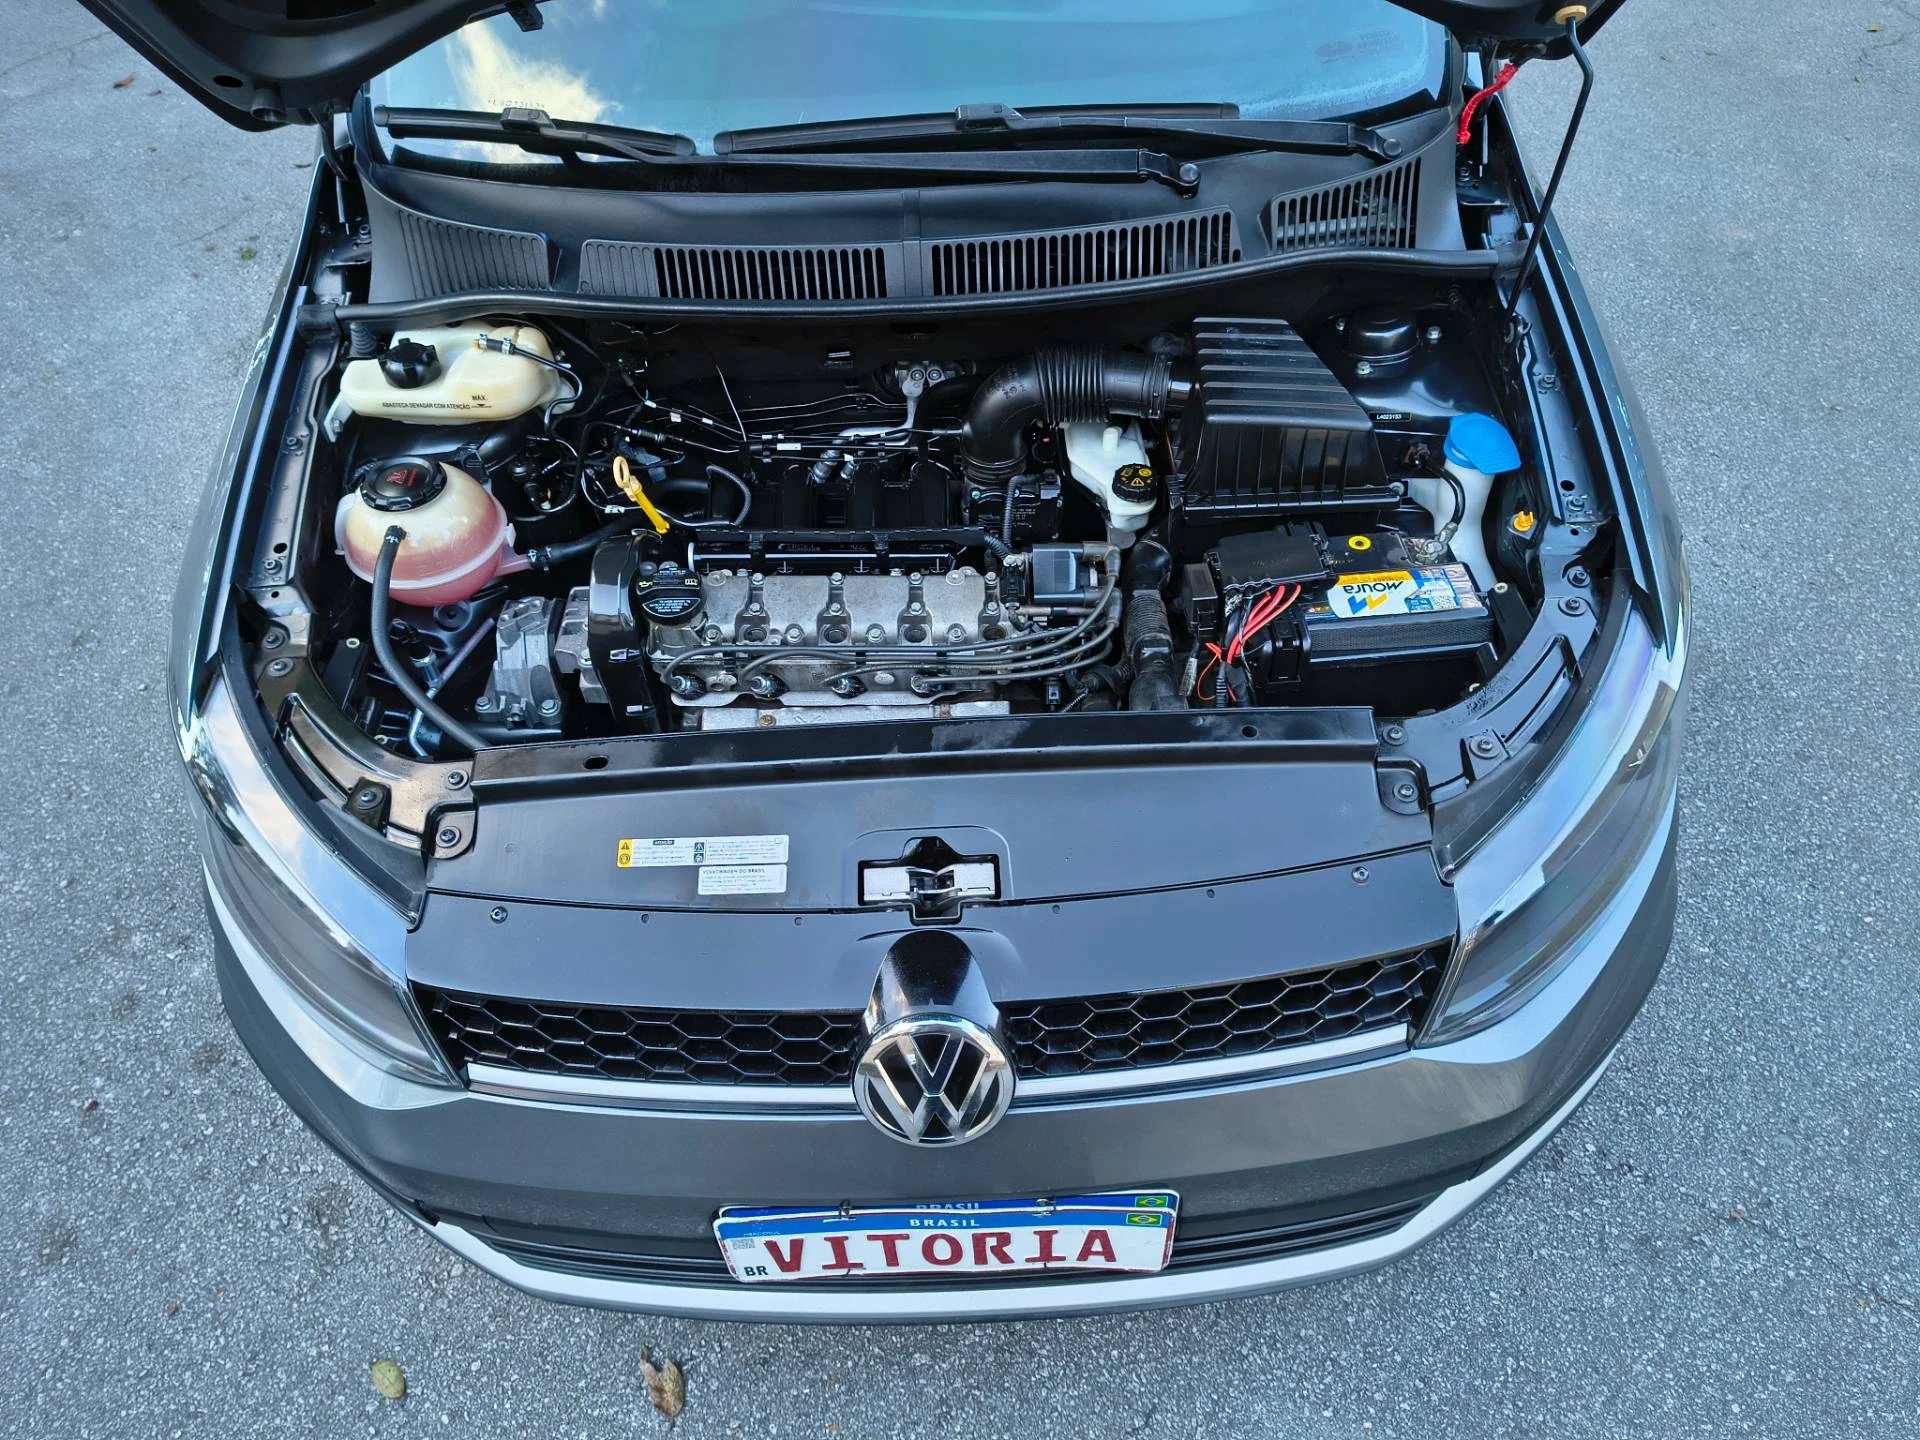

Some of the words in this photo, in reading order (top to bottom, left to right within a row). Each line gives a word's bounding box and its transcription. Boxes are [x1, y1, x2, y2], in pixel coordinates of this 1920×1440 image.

[910, 1219, 980, 1228] BRASIL
[763, 1229, 1117, 1273] VITORIA
[744, 1265, 768, 1277] BR
